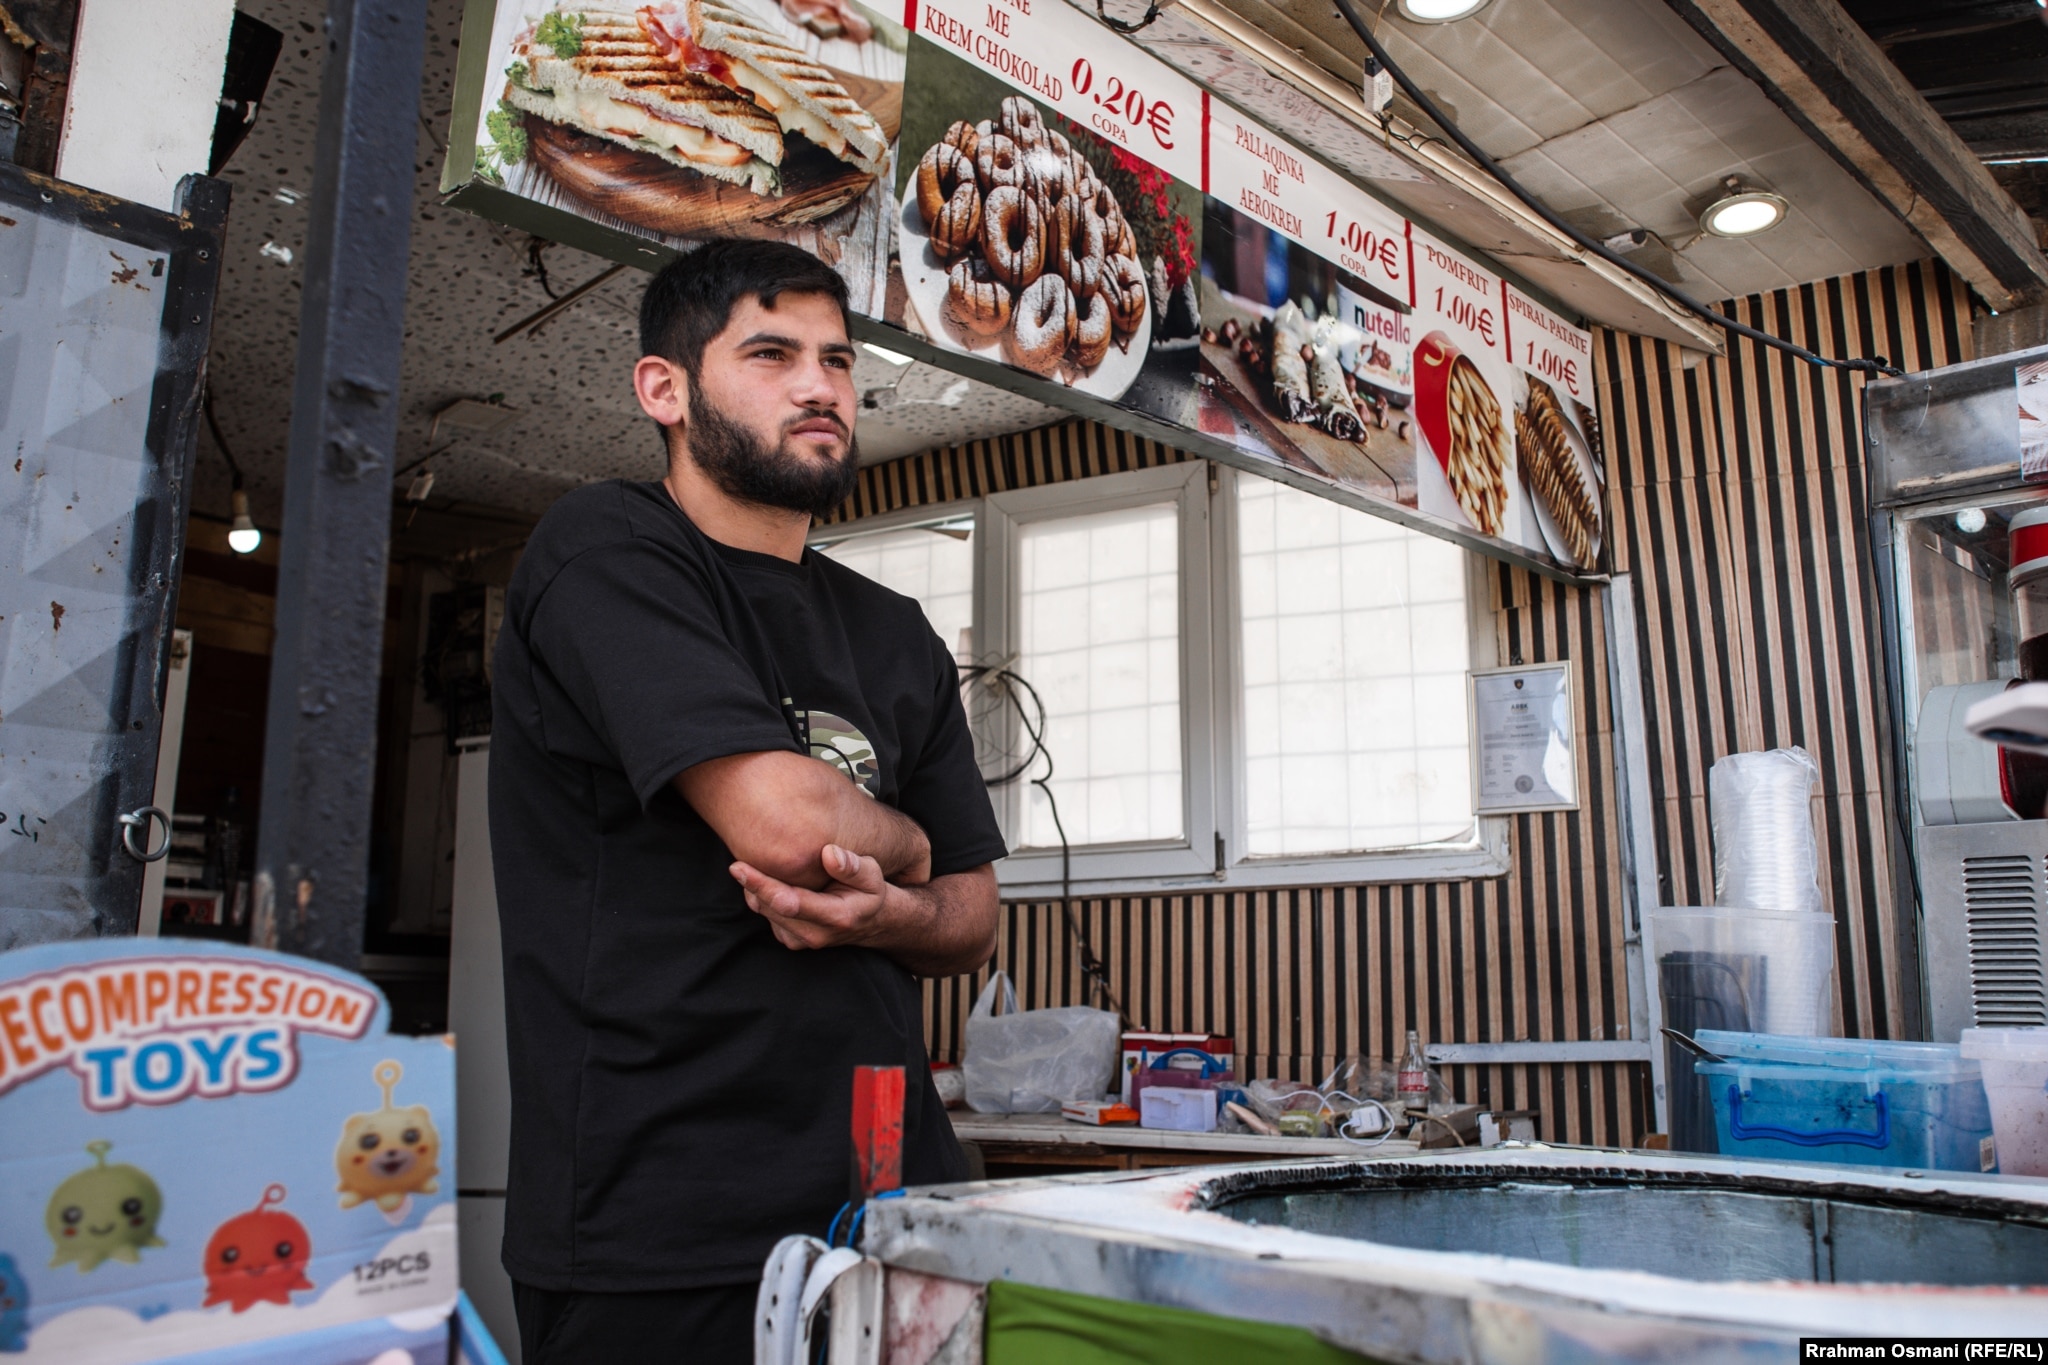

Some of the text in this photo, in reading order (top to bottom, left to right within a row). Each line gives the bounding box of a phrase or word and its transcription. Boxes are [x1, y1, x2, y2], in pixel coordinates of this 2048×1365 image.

[986, 4, 1010, 39] ME
[924, 5, 1063, 102] KREM CHOKOLAD
[1070, 57, 1175, 151] 0.20€
[1092, 113, 1128, 144] COPA
[1235, 124, 1305, 184] PALLAQINKA
[1262, 169, 1280, 197] ME
[1239, 188, 1303, 239] AEROKREM
[1326, 210, 1400, 280] 1.00€
[1341, 253, 1367, 278] COPA
[1427, 245, 1489, 296] POMFRIT
[1435, 286, 1496, 348] 1.00€
[1508, 293, 1588, 355] SPIRAL PATATE
[1526, 340, 1580, 396] 1.00€
[0, 970, 361, 1080] ECOMPRESSION
[85, 1029, 283, 1098] TOYS
[353, 1250, 431, 1282] 12PCS
